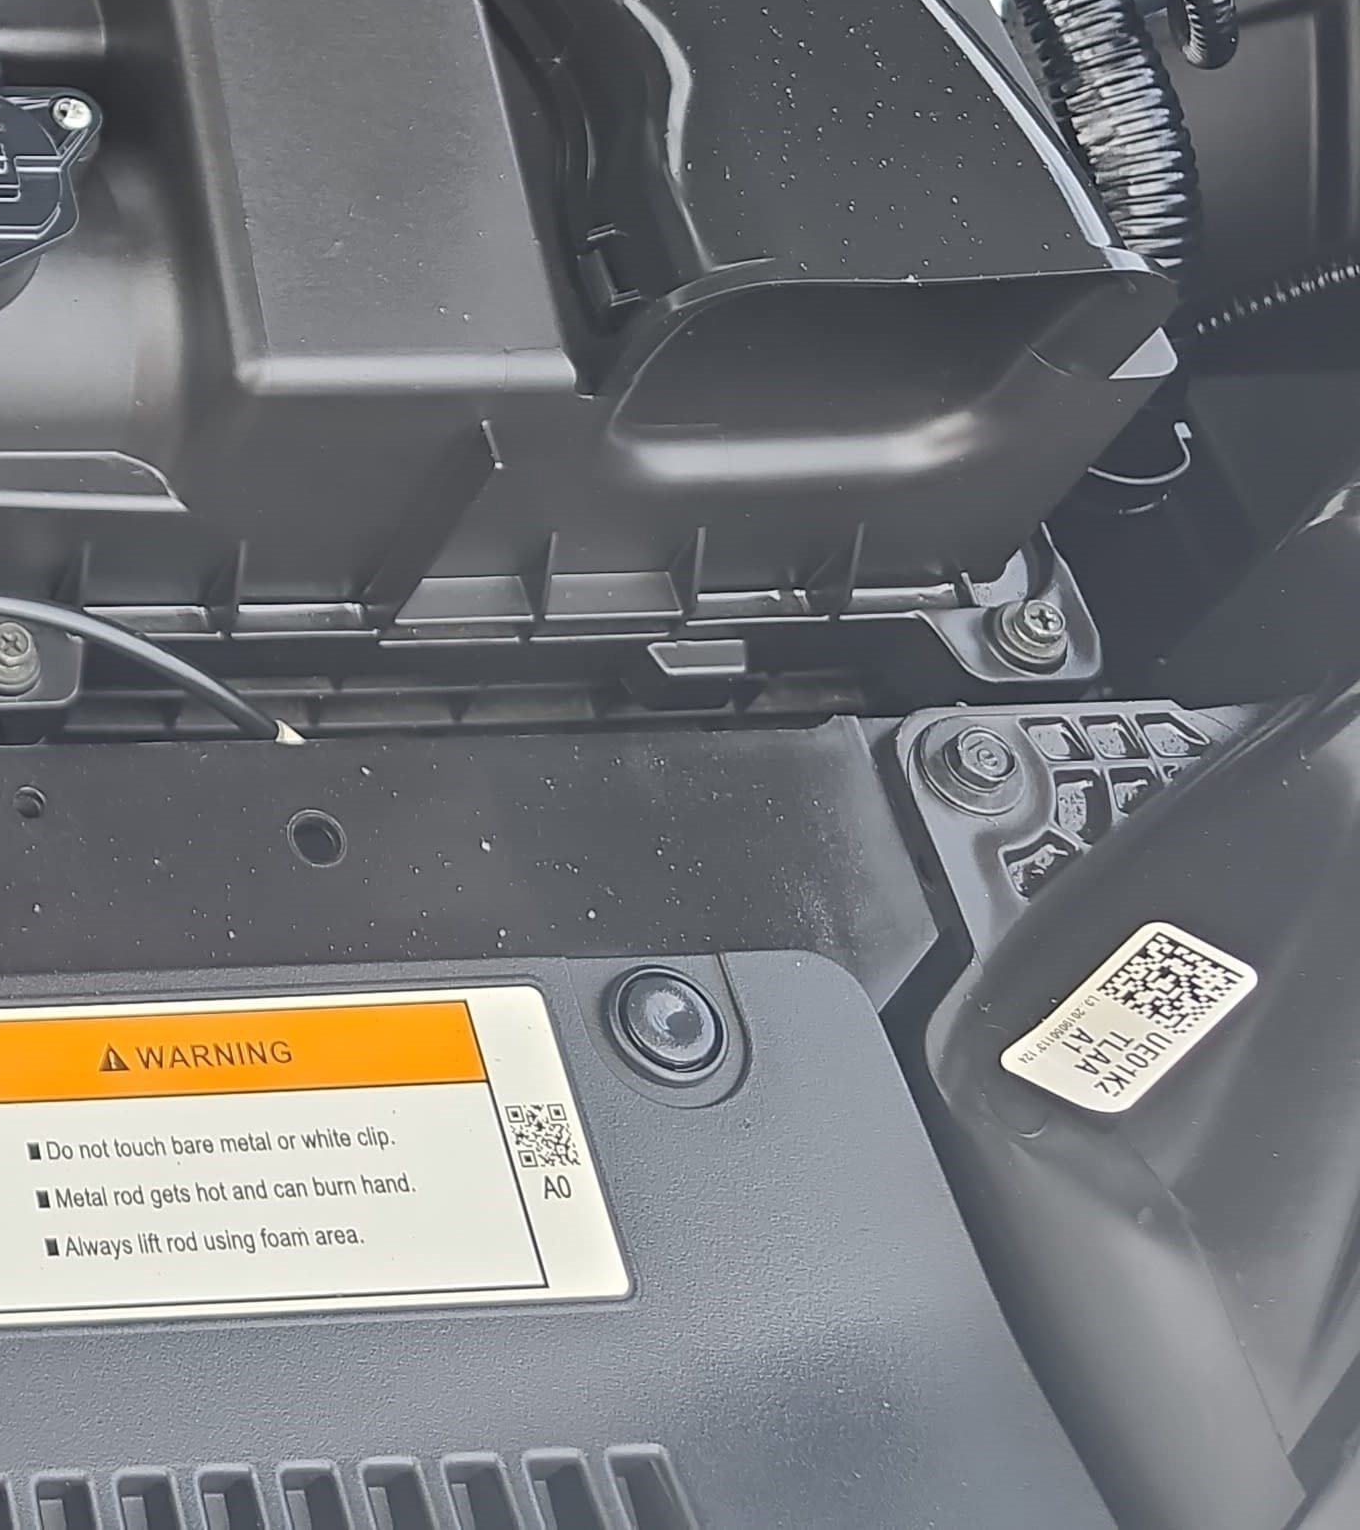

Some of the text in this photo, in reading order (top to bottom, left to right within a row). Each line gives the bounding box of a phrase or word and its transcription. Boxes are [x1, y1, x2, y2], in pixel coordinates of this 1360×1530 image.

[136, 1041, 293, 1070] WARNING
[1061, 1026, 1094, 1054] A1
[1073, 1031, 1135, 1075] TLAA
[46, 1126, 396, 1160] Do not touch bare metal or white clip.
[55, 1172, 417, 1209] Metal rod gets hot and can burn hand.
[544, 1174, 572, 1200] A0
[65, 1228, 365, 1261] Always lift rod using foam area.
